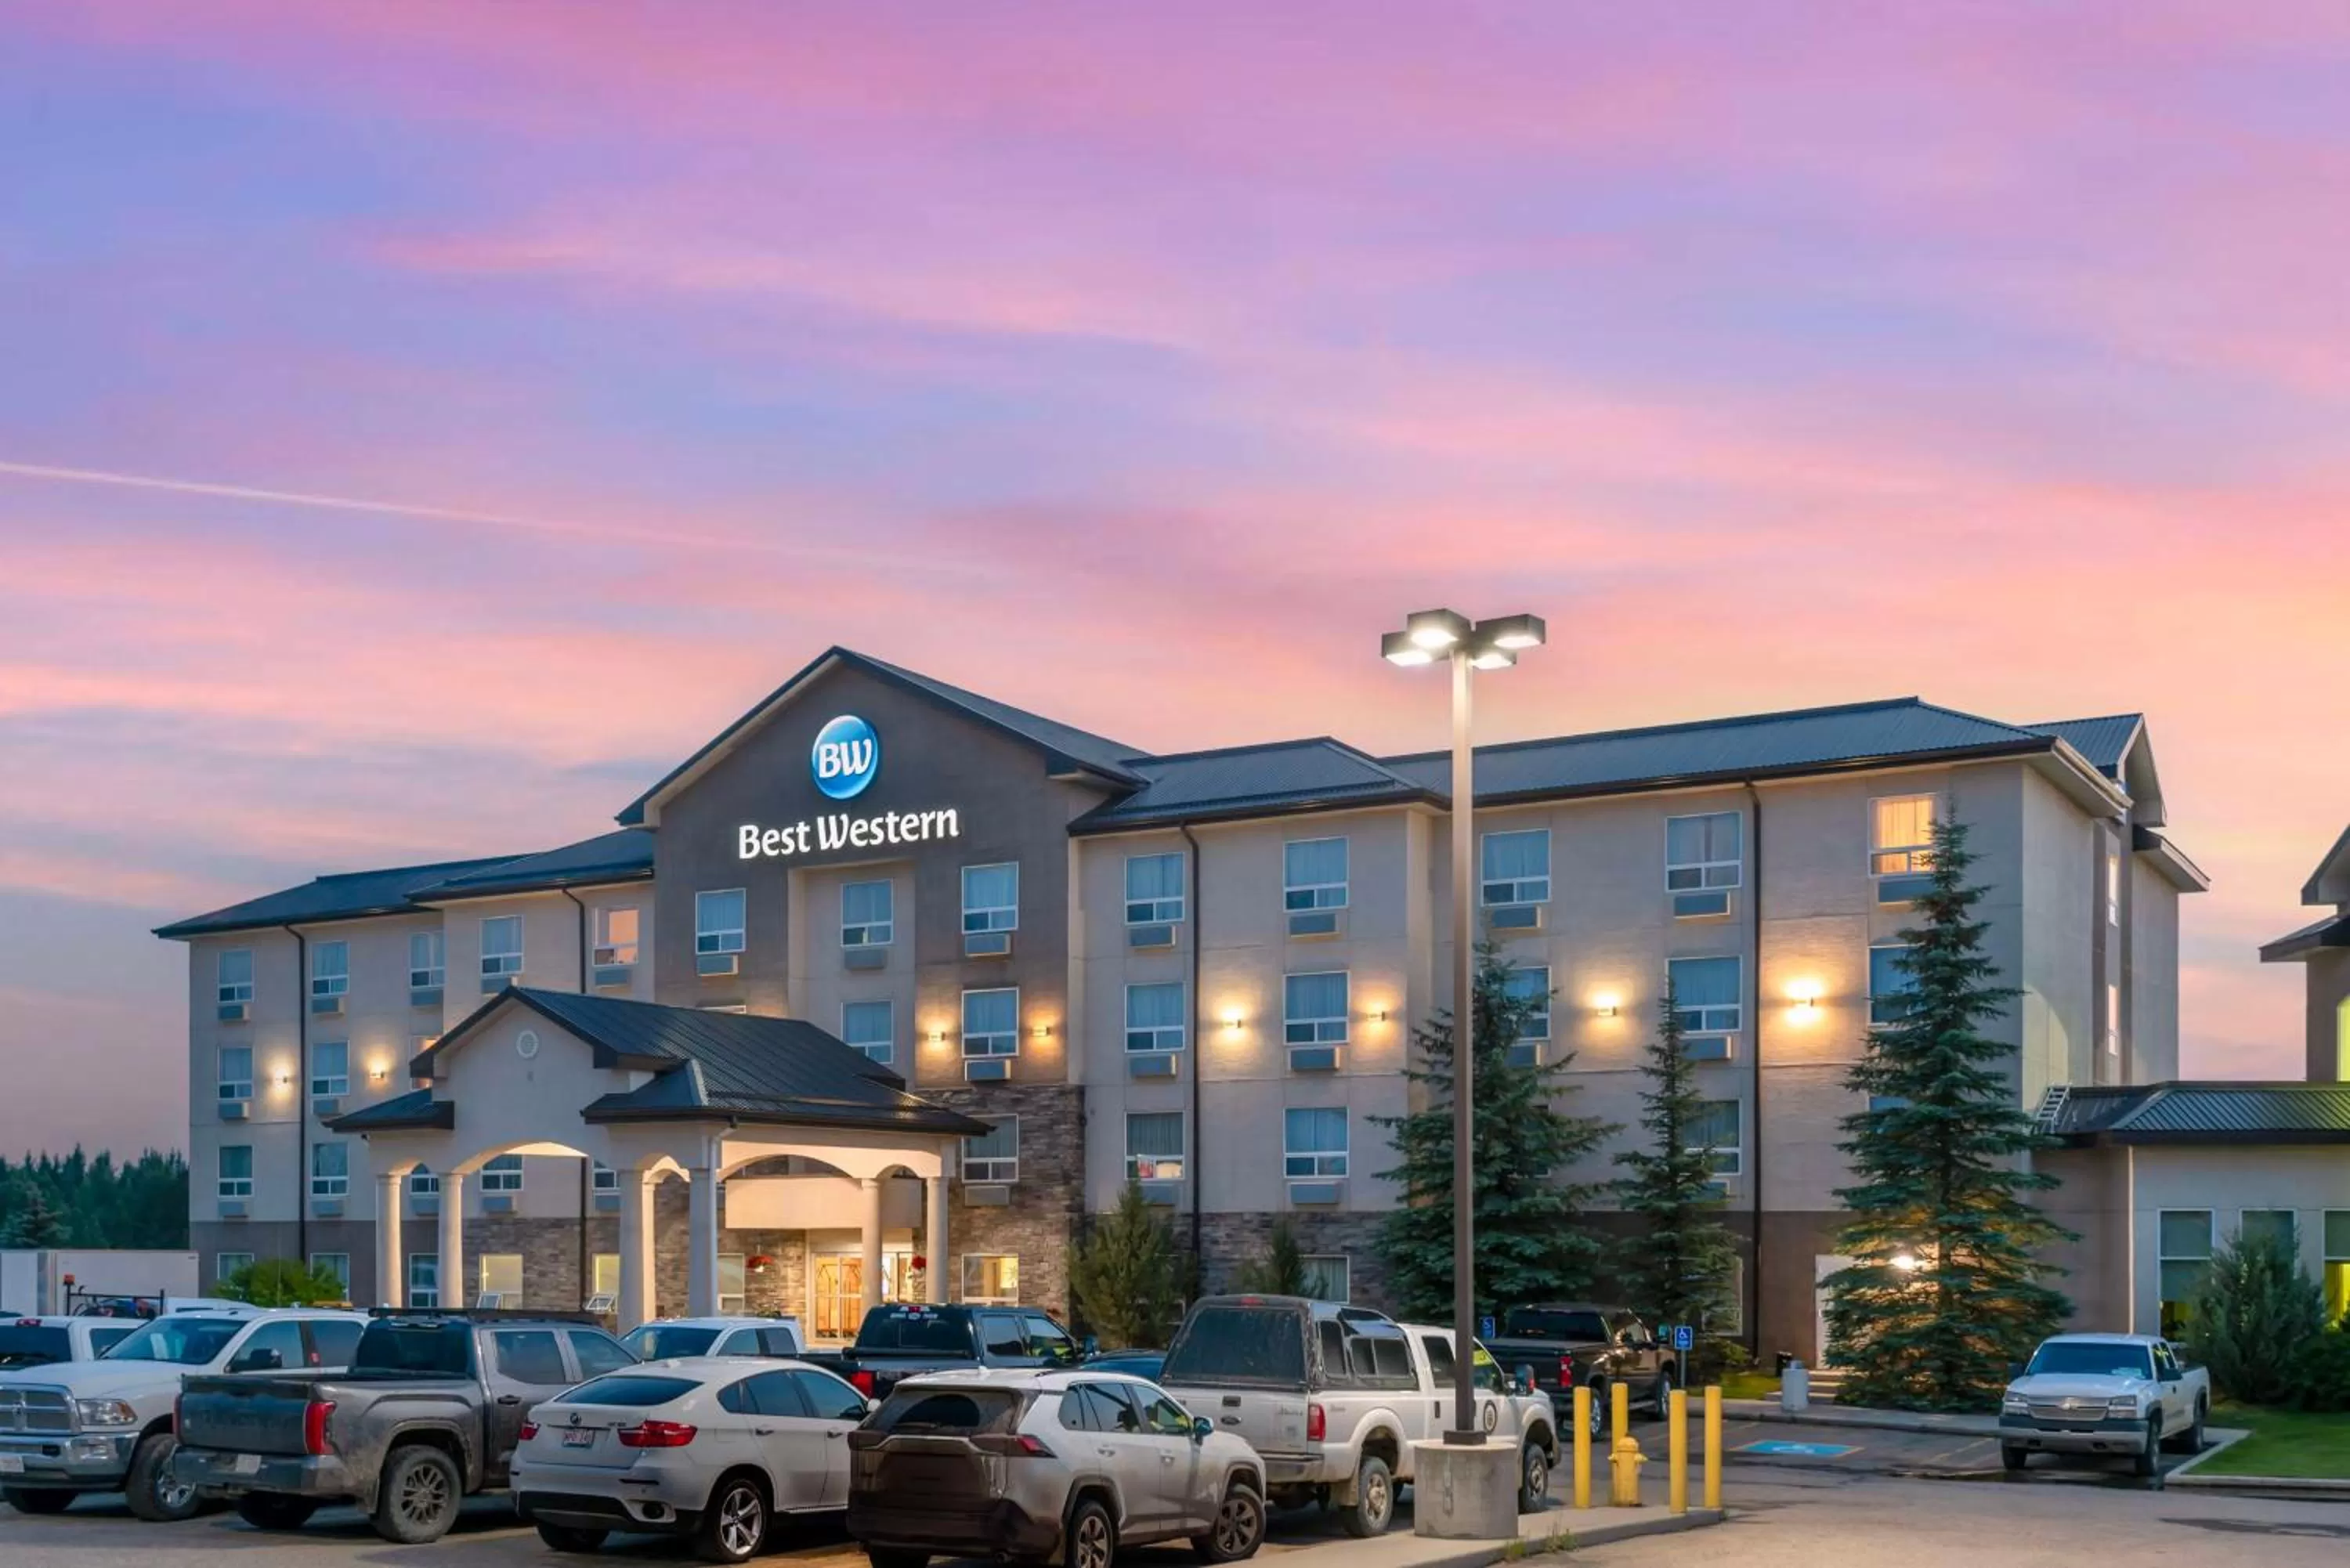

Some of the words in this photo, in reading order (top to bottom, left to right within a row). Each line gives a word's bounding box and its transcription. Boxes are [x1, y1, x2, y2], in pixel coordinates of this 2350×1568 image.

[819, 739, 871, 778] BW
[739, 821, 811, 859] Best
[817, 808, 960, 851] Western
